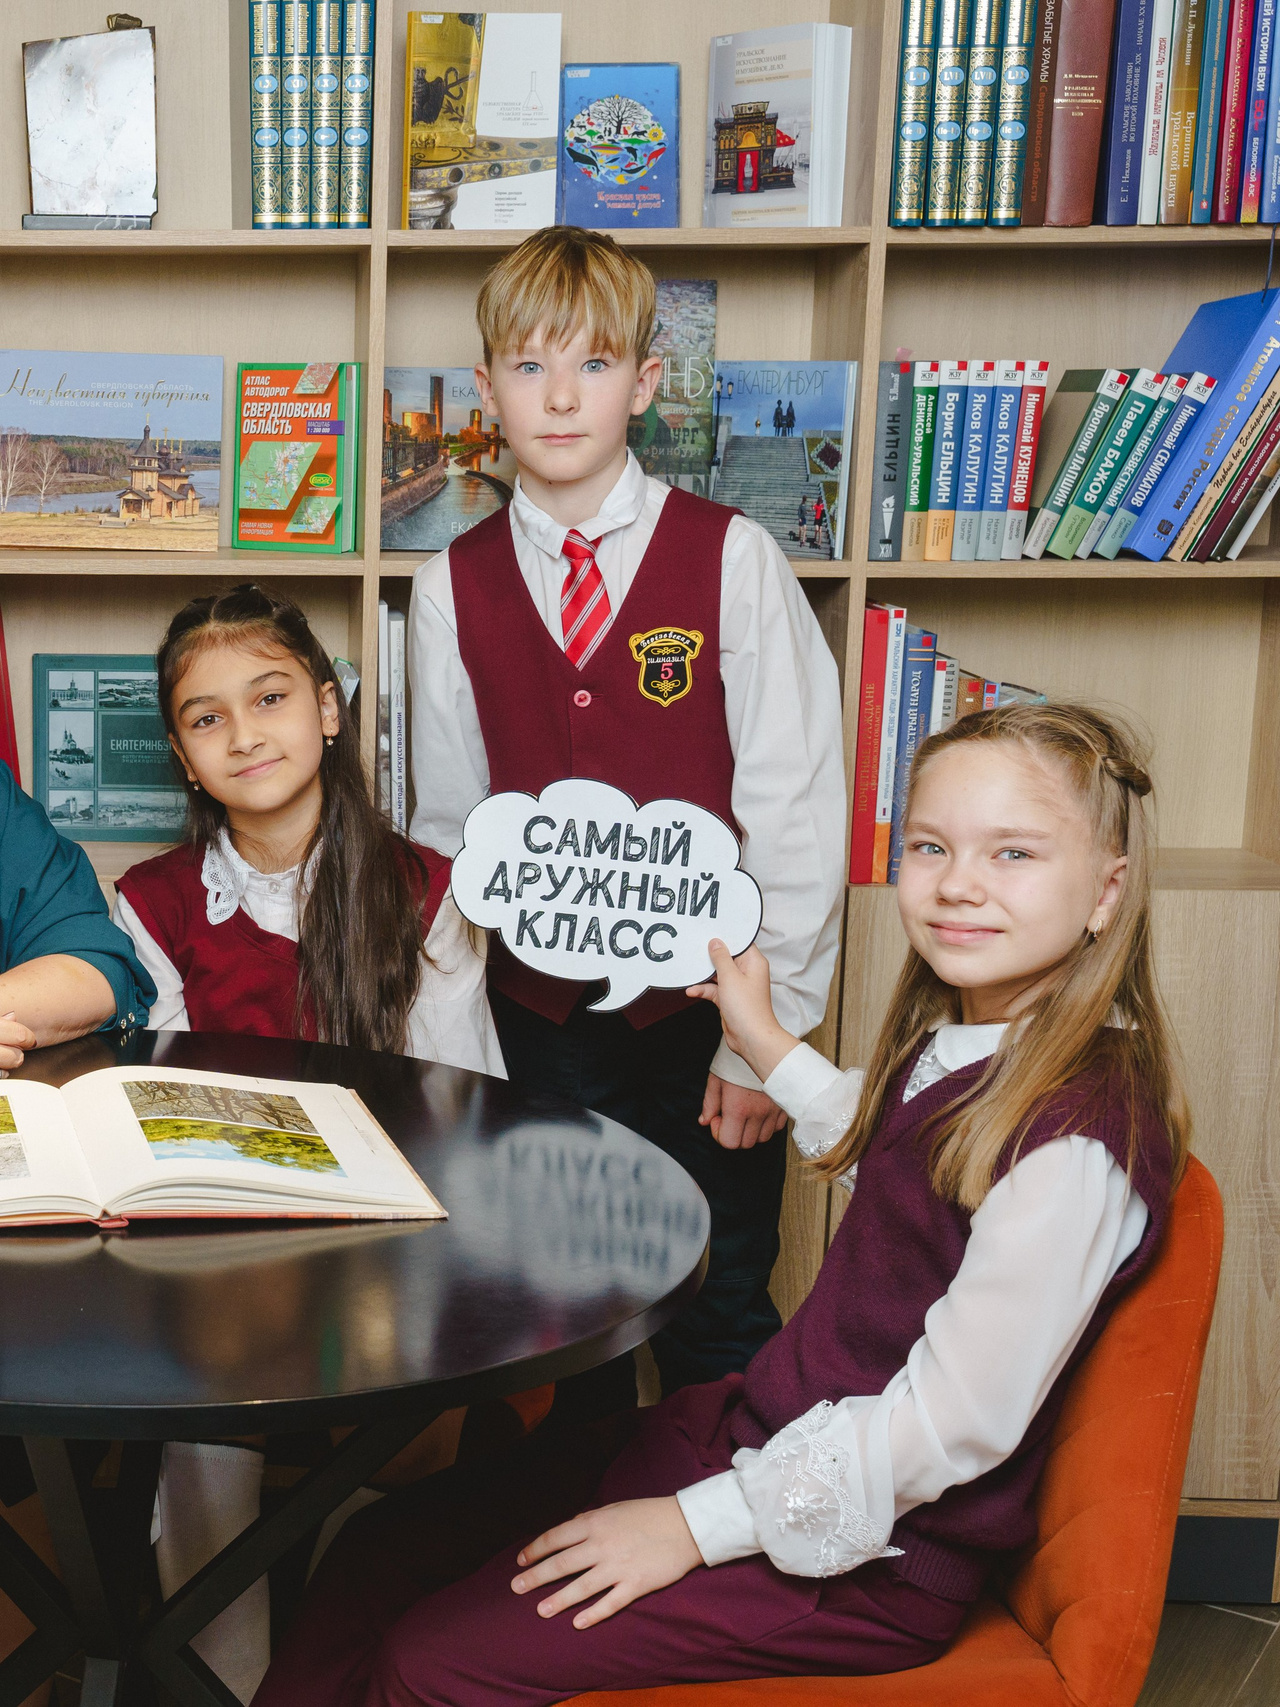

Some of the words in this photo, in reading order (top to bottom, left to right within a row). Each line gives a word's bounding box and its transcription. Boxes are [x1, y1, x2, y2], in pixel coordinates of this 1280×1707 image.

[1185, 23, 1195, 66] Лукьянин
[1259, 18, 1270, 63] ИСТОРИИ
[1040, 47, 1051, 82] ХРАМЫ
[1125, 62, 1133, 102] ЗАВОДЧИКИ
[1132, 66, 1141, 103] ПОЛОВИНЕ
[1256, 66, 1265, 91] ВЕХИ
[1034, 86, 1048, 158] Свердловской
[1122, 104, 1130, 142] УРАЛЬСКИЕ
[1130, 105, 1138, 132] ВТОРОЙ
[1254, 99, 1265, 120] 50
[1129, 133, 1136, 142] ВО
[1168, 111, 1182, 171] уральской
[1182, 111, 1195, 168] Вершины
[1249, 137, 1259, 182] БЕЛОЯРСКОЙ
[1030, 161, 1041, 202] области
[1165, 174, 1178, 207] науки
[91, 382, 154, 390] СВЕРДЛОВСКАЯ
[134, 380, 211, 408] губерния
[245, 376, 270, 385] АТЛАС
[245, 387, 289, 397] АВТОДОРОГ
[738, 370, 829, 396] ЕКАТЕРИНБУРГ
[242, 402, 331, 420] СВЕРДЛОВСКАЯ
[242, 419, 292, 435] ОБЛАСТЬ
[925, 395, 935, 434] Алексей
[942, 393, 959, 438] Борис
[971, 393, 986, 429] Яков
[998, 393, 1014, 429] Яков
[1021, 393, 1040, 442] Николай
[1077, 402, 1110, 453] Ярополк
[1113, 400, 1145, 447] Павел
[1146, 406, 1169, 435] Эрнст
[1163, 404, 1196, 450] Николай
[884, 413, 900, 482] ЕЛЬЦИН
[909, 394, 926, 505] ДЕНИСОВ-УРАЛЬСКИЙ
[1249, 439, 1271, 477] PRODUCTION
[936, 441, 954, 503] ЕЛЬЦИН
[963, 434, 983, 504] КАЛУГИН
[990, 434, 1009, 504] КАЛУГИН
[1013, 445, 1031, 503] КУЗНЕЦОВ
[1053, 454, 1085, 507] ЛАПШИН
[1084, 448, 1121, 504] БАЖОВ
[1106, 436, 1152, 508] НЕИЗВЕСТНЫЙ
[1131, 450, 1170, 507] СЕМИХАТОВ
[1231, 477, 1250, 504] VICTORIES
[647, 656, 685, 664] гимназия
[661, 663, 673, 680] 5
[909, 671, 922, 707] НАРОД
[942, 663, 955, 717] ИСПОВЕДЬ
[395, 712, 403, 773] искусствознании
[396, 781, 404, 810] методы
[523, 815, 692, 867] САМЫЙ
[483, 860, 720, 919] ДРУЖНЫЙ
[516, 909, 678, 962] КЛАСС
